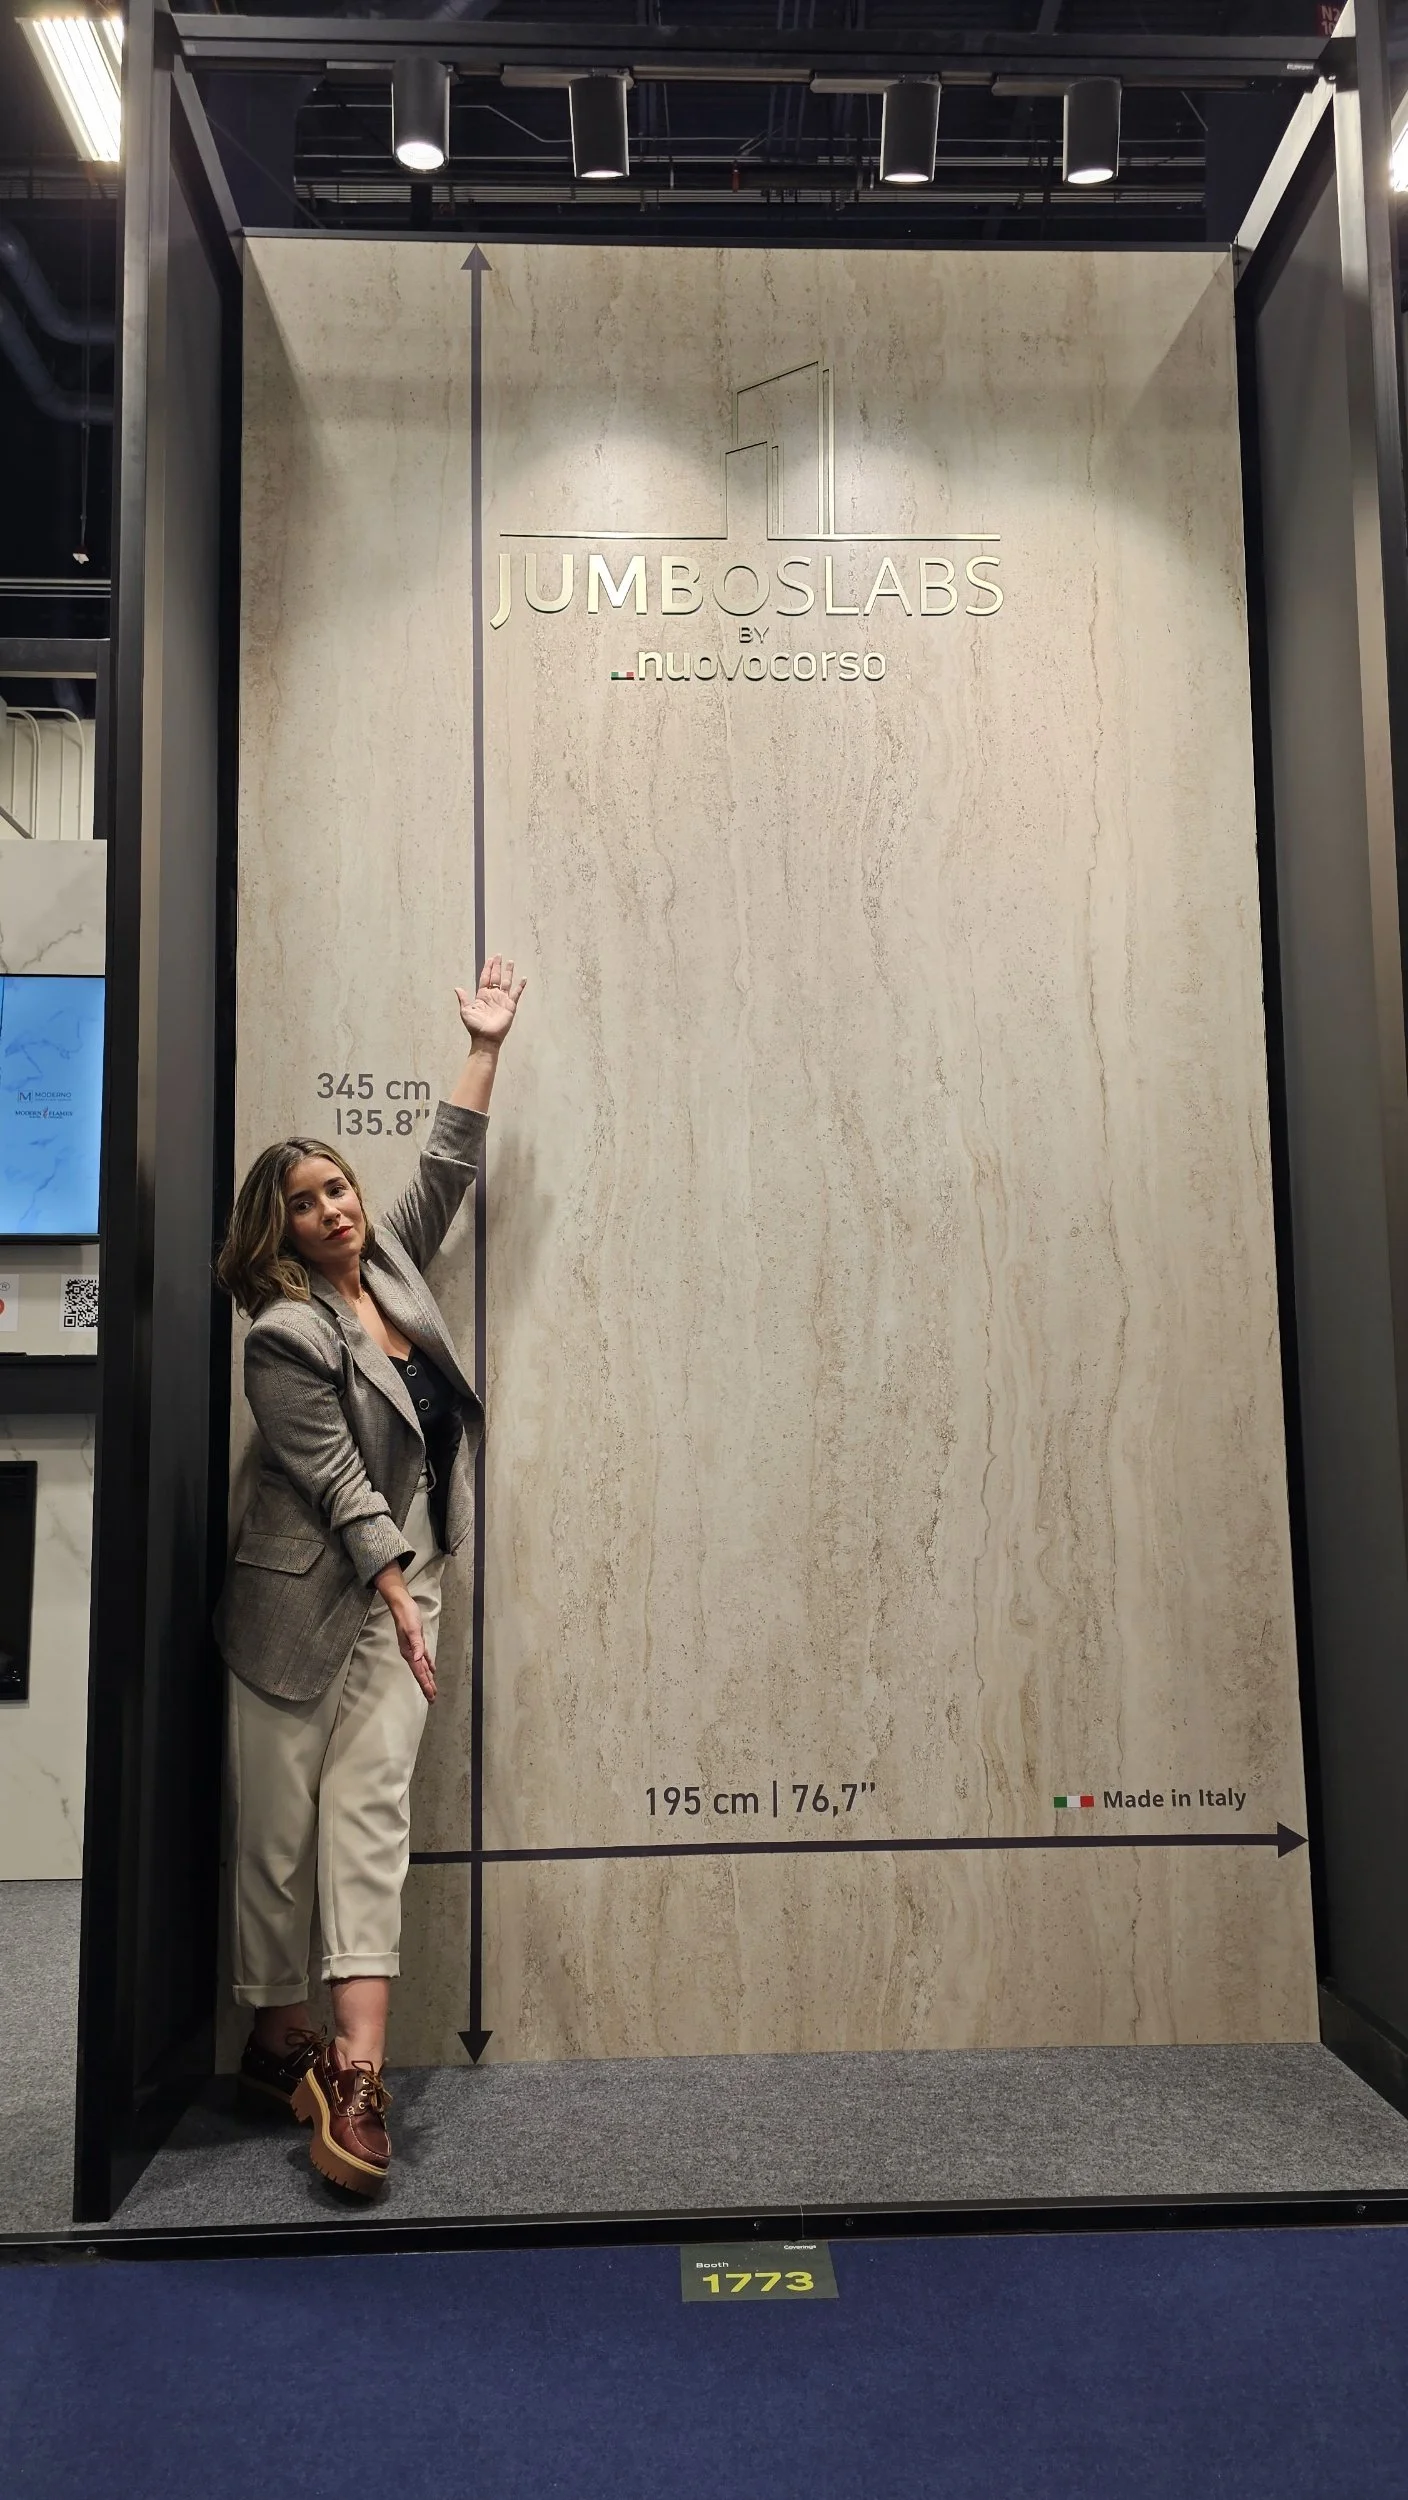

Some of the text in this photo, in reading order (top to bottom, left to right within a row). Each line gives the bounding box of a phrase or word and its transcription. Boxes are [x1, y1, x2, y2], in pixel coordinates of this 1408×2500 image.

[490, 553, 1005, 629] JUMBOSLABS
[738, 626, 769, 643] BY
[638, 650, 887, 681] nuovocorso
[317, 1072, 431, 1100] 345 cm
[646, 1786, 701, 1816] 195
[713, 1791, 759, 1815] cm
[1103, 1787, 1247, 1811] Made in Italy
[696, 2261, 729, 2269] Booth
[702, 2271, 815, 2294] 1773
